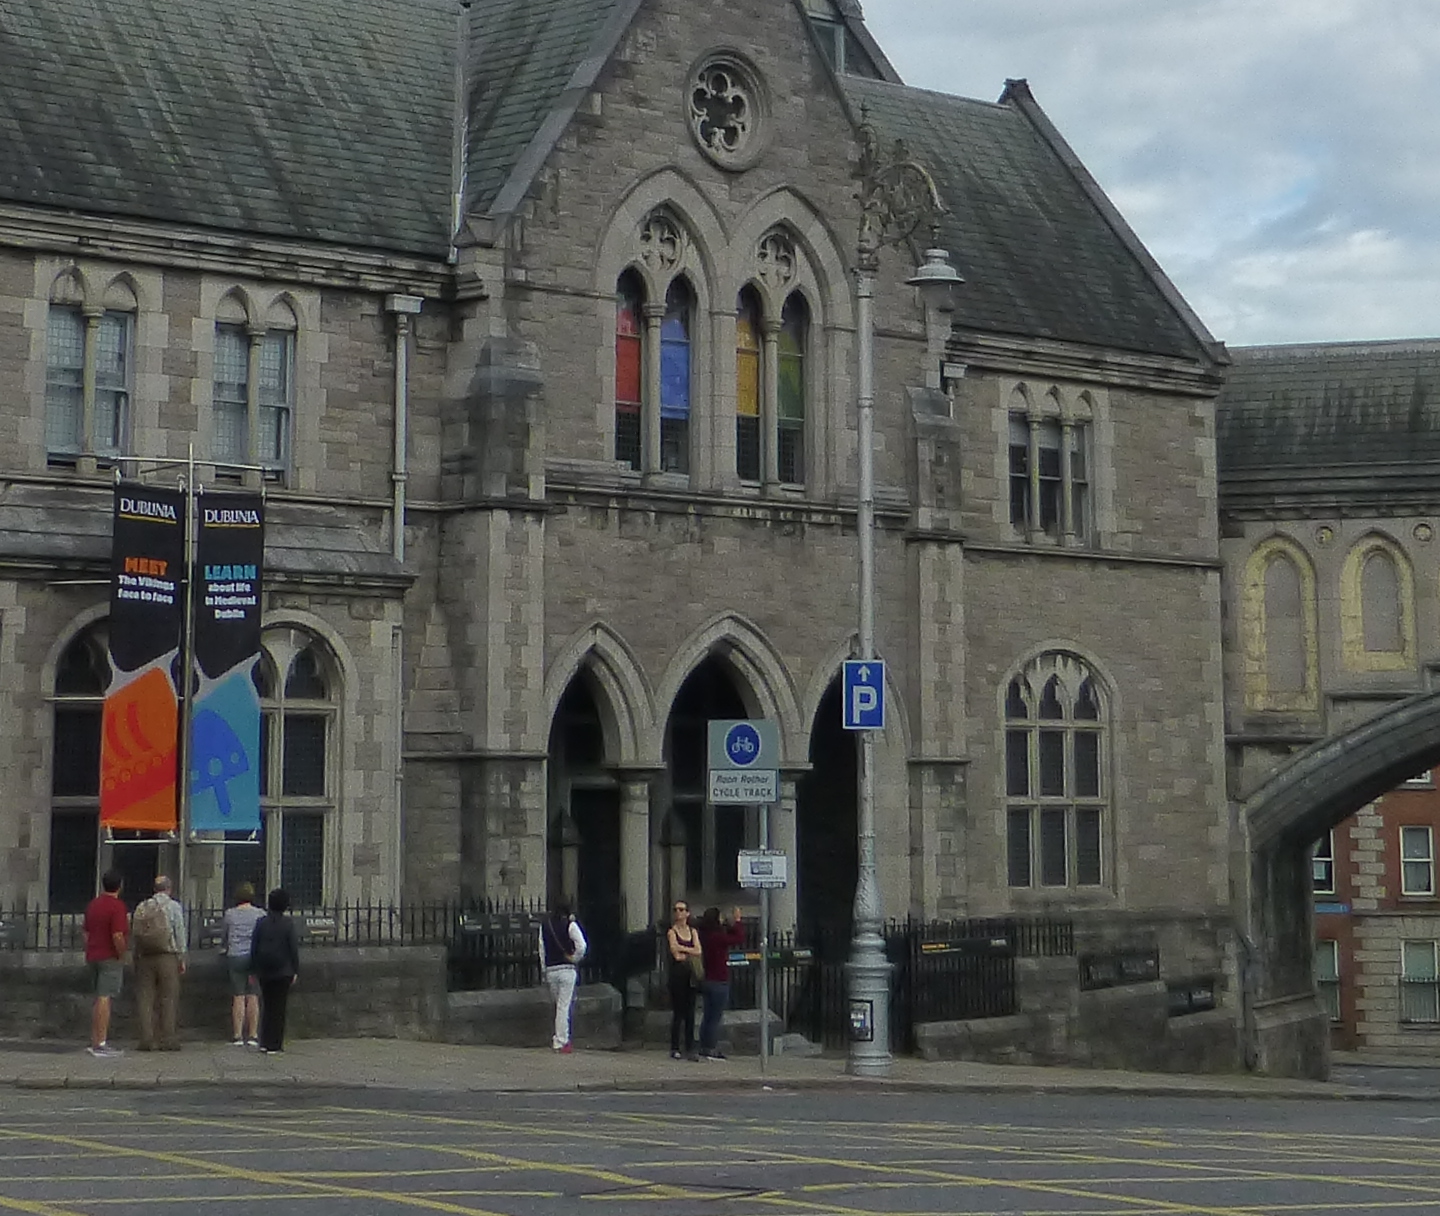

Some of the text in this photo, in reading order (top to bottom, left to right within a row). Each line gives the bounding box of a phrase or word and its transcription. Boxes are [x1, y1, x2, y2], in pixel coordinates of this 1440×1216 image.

[120, 497, 176, 519] DUBLINIA
[204, 509, 259, 524] DUBLINIA
[125, 557, 168, 576] MEET
[204, 564, 257, 581] LEARN
[208, 583, 235, 592] about
[852, 686, 878, 724] P
[713, 788, 773, 798] CYCLE TRACK
